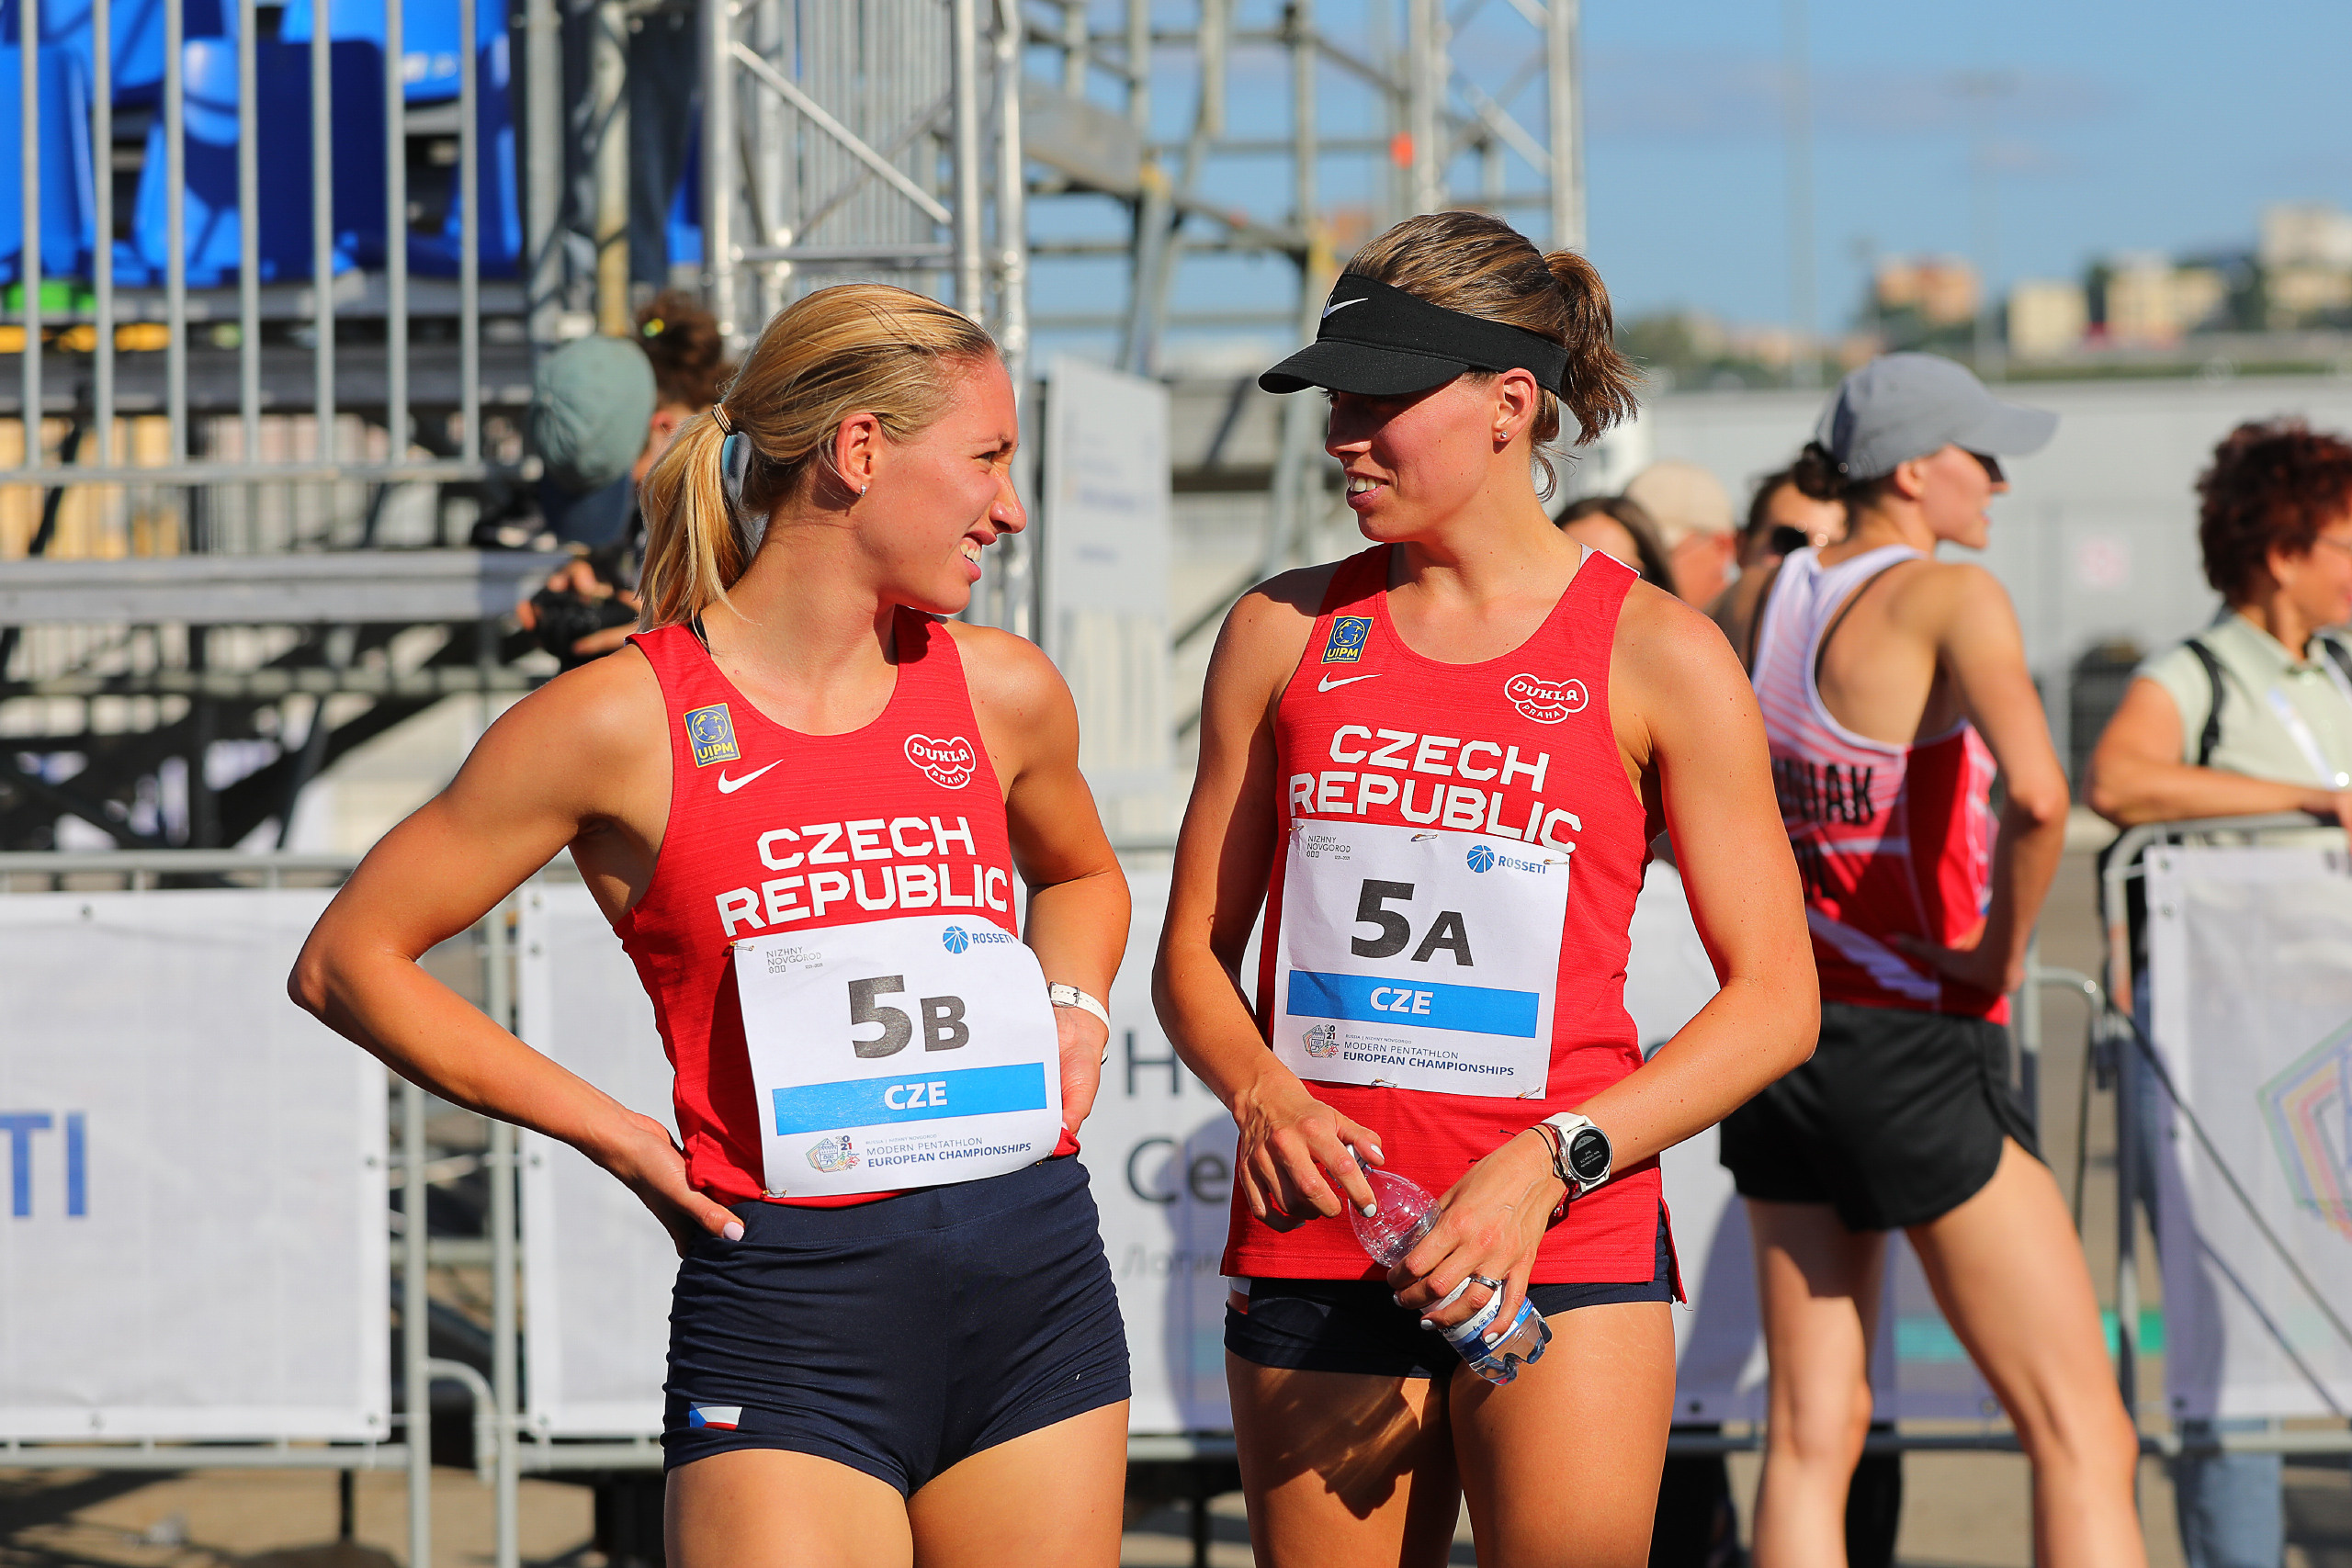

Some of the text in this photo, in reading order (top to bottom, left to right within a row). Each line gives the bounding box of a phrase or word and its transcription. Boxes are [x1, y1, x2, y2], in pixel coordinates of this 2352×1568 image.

[1327, 648, 1359, 658] UIPM
[1512, 680, 1579, 701] DUKLA
[1522, 705, 1561, 718] PRAHA
[697, 742, 735, 759] UIPM
[912, 742, 970, 762] DUKLA
[1329, 724, 1551, 793] CZECH
[932, 771, 966, 784] PRAHA
[1289, 771, 1583, 853] REPUBLIC
[756, 816, 977, 872] CZECH
[1306, 842, 1351, 853] NOVGOROD
[1307, 835, 1337, 844] NIZHNY
[1498, 855, 1546, 874] ROSSETI
[715, 863, 1009, 938] REPUBLIC
[766, 946, 803, 959] NIZHNY
[767, 952, 822, 966] NOVGOROD
[1370, 986, 1434, 1015] CZE
[1344, 1042, 1459, 1060] MODERN PENTATHLON
[1343, 1052, 1515, 1076] EUROPEAN CHAMPIONSHIPS
[884, 1081, 948, 1111] CZE
[866, 1137, 983, 1156] MODERN PENTATHLON
[868, 1142, 1032, 1168] EUROPEAN CHAMPIONSHIPS
